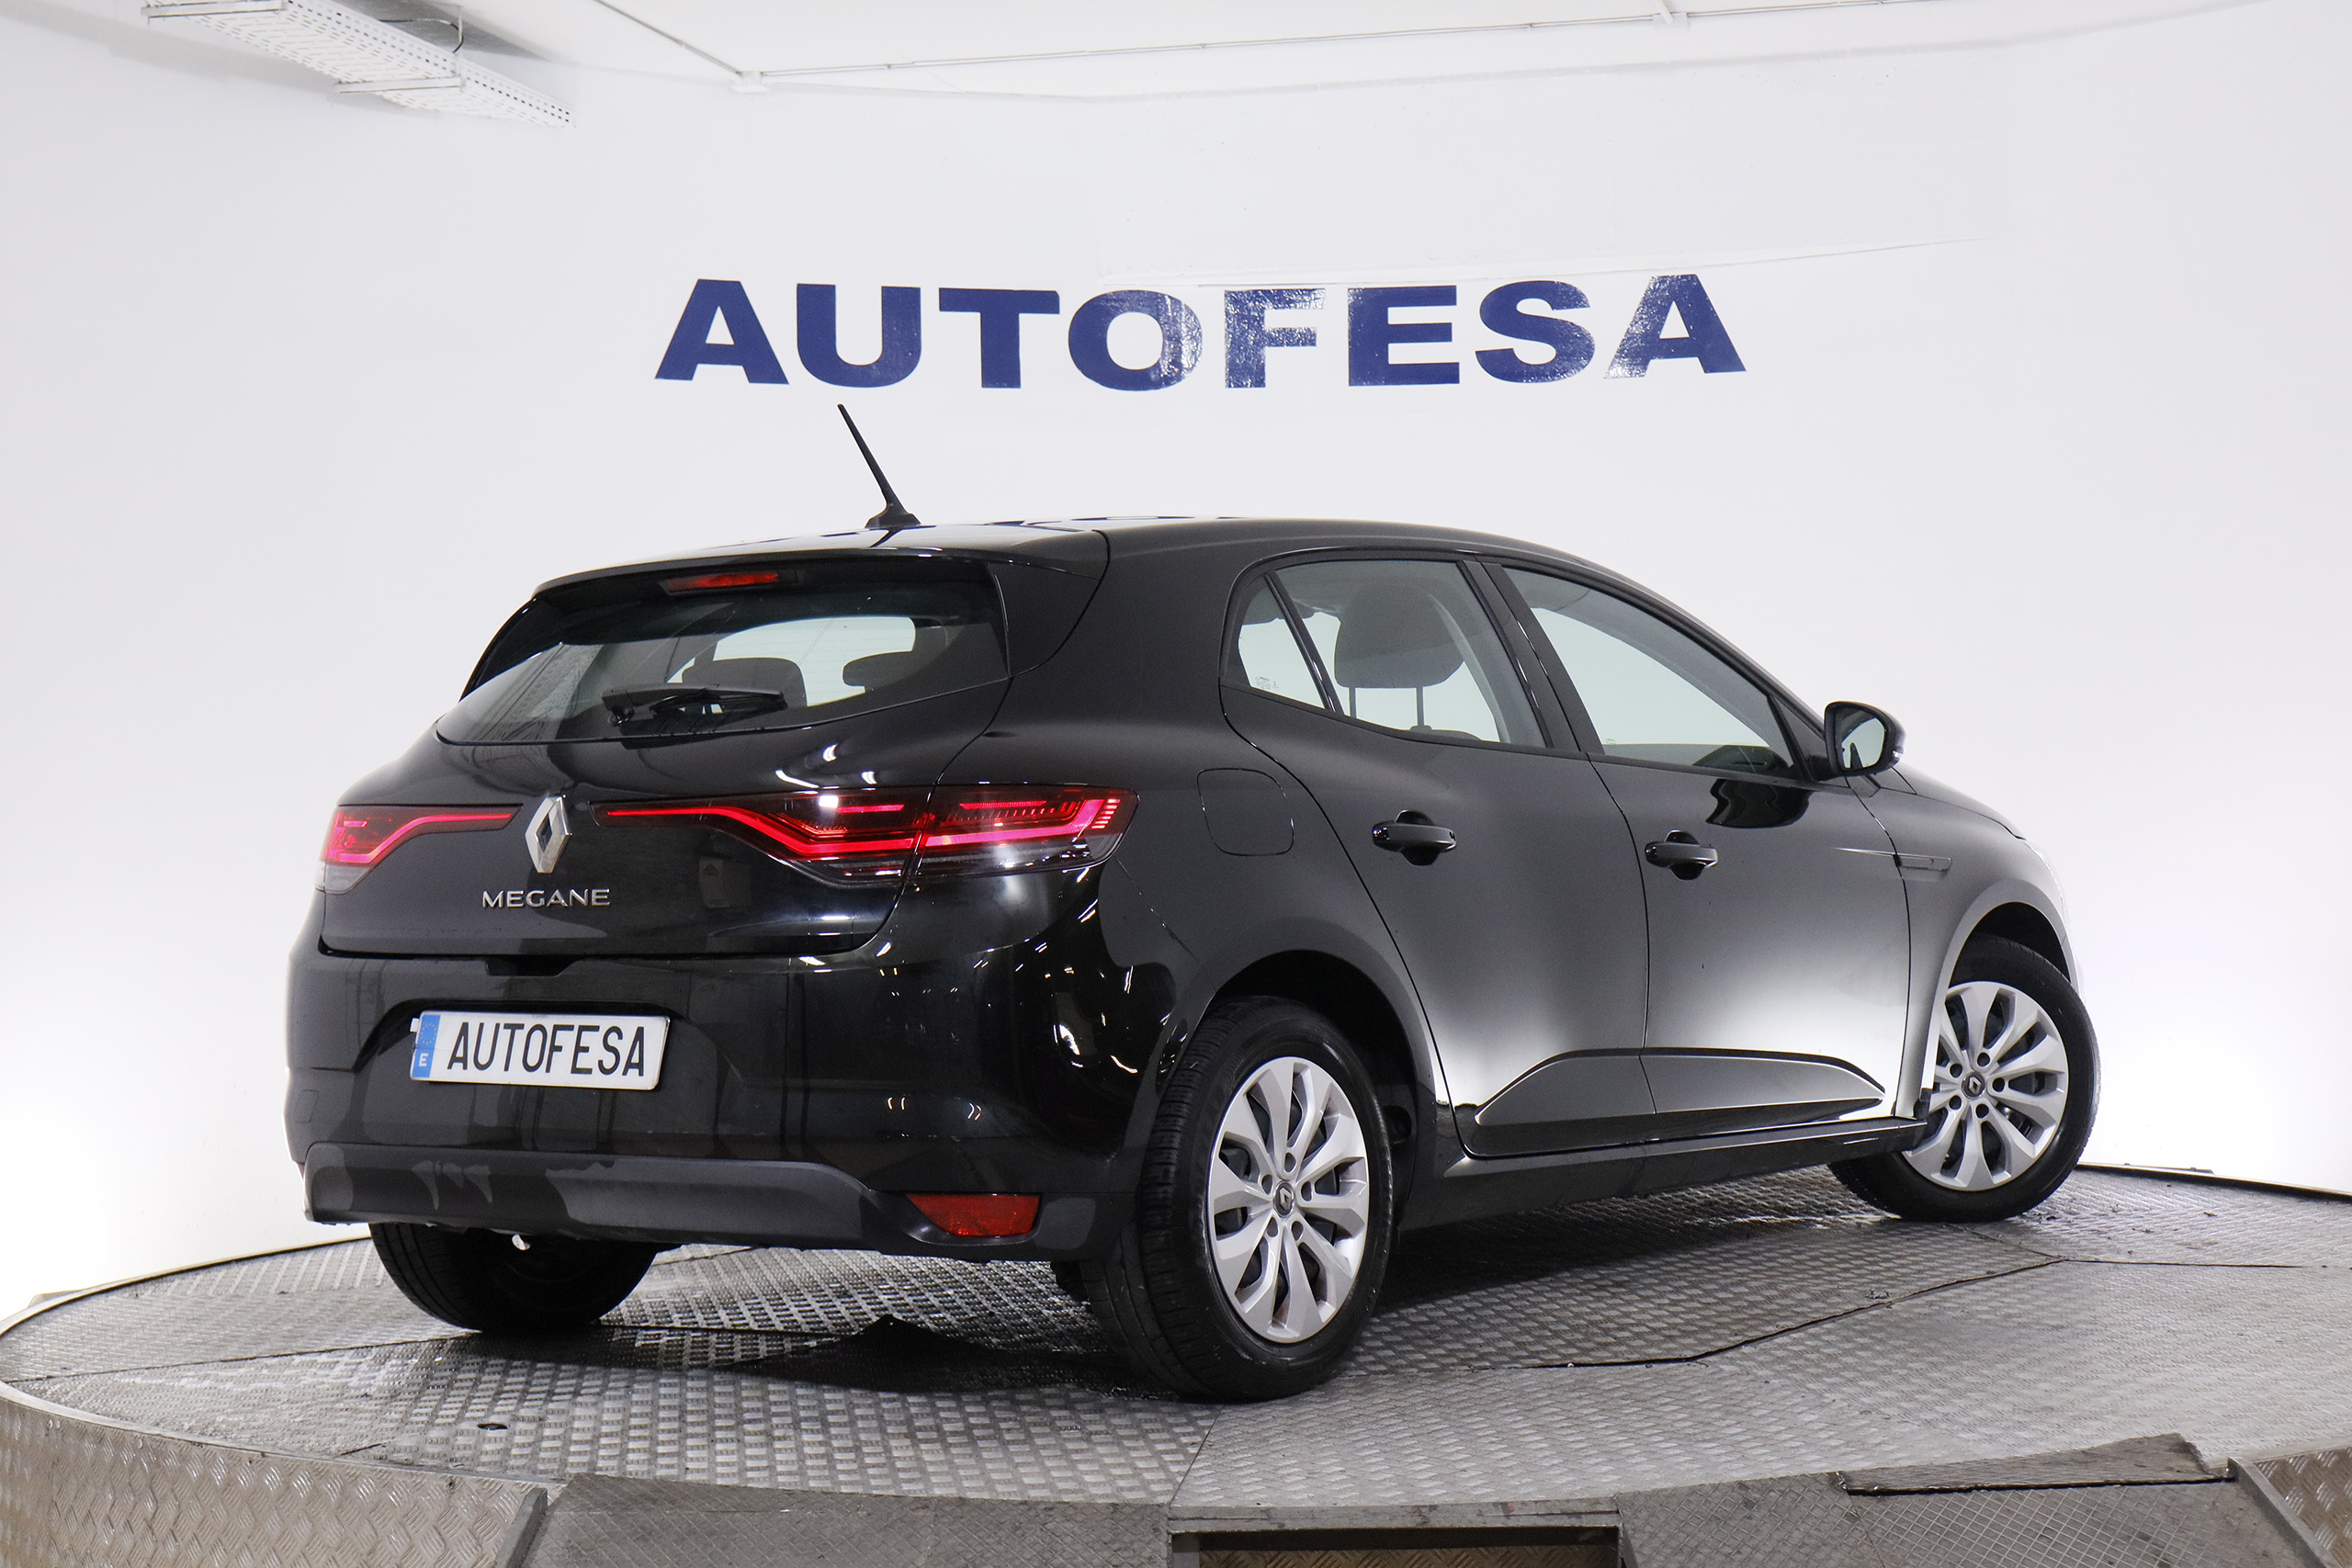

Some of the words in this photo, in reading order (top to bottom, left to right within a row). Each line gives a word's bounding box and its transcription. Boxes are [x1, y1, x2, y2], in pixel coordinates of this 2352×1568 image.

[655, 275, 1747, 392] AUTOFESA
[481, 888, 611, 908] MEGANE
[418, 1053, 429, 1067] E
[447, 1021, 645, 1077] AUTOFESA
